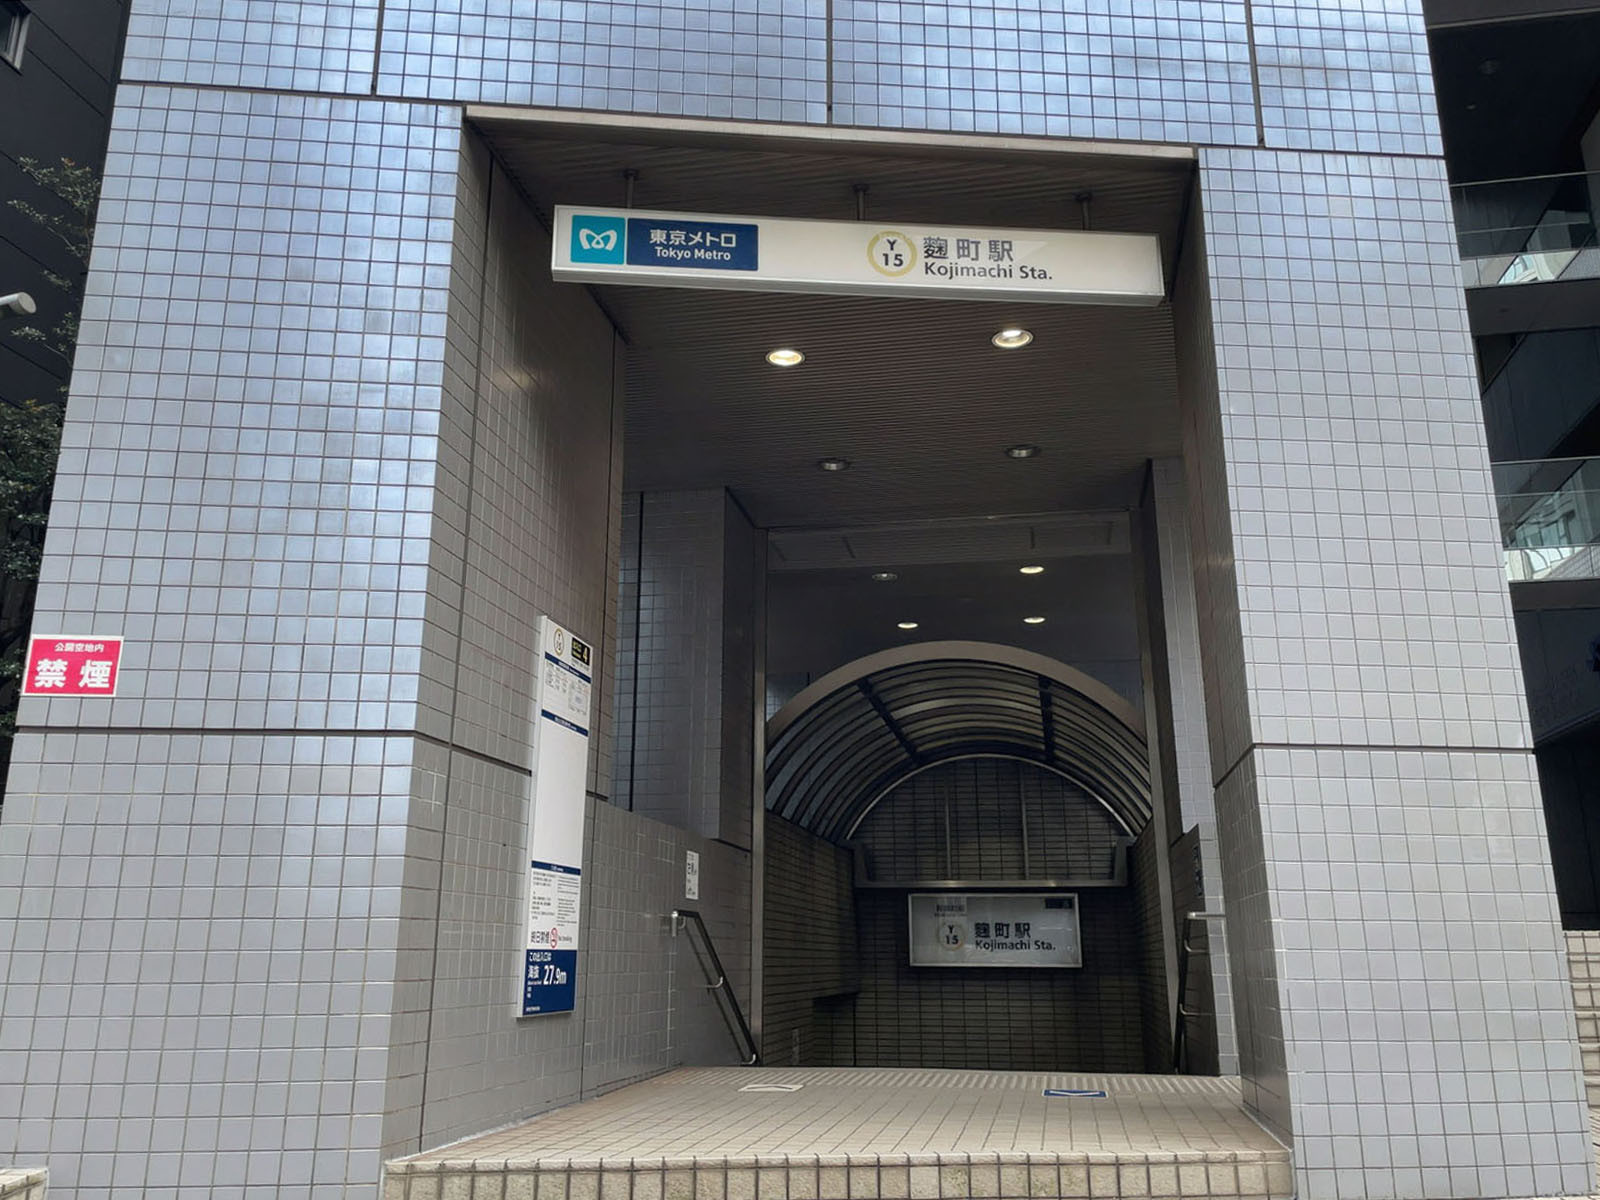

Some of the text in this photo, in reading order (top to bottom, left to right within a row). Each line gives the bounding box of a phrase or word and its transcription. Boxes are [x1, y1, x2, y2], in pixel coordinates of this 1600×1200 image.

[649, 229, 736, 248] 東京メトロ
[886, 238, 898, 251] Y
[654, 246, 731, 261] Tokyo Metro
[882, 253, 904, 267] 15
[924, 262, 1053, 280] Kojimachi Sta.
[34, 658, 113, 688] 禁煙
[946, 935, 959, 945] 15
[975, 940, 1056, 952] Kojimachi Sta.
[543, 964, 567, 985] 27.9m
